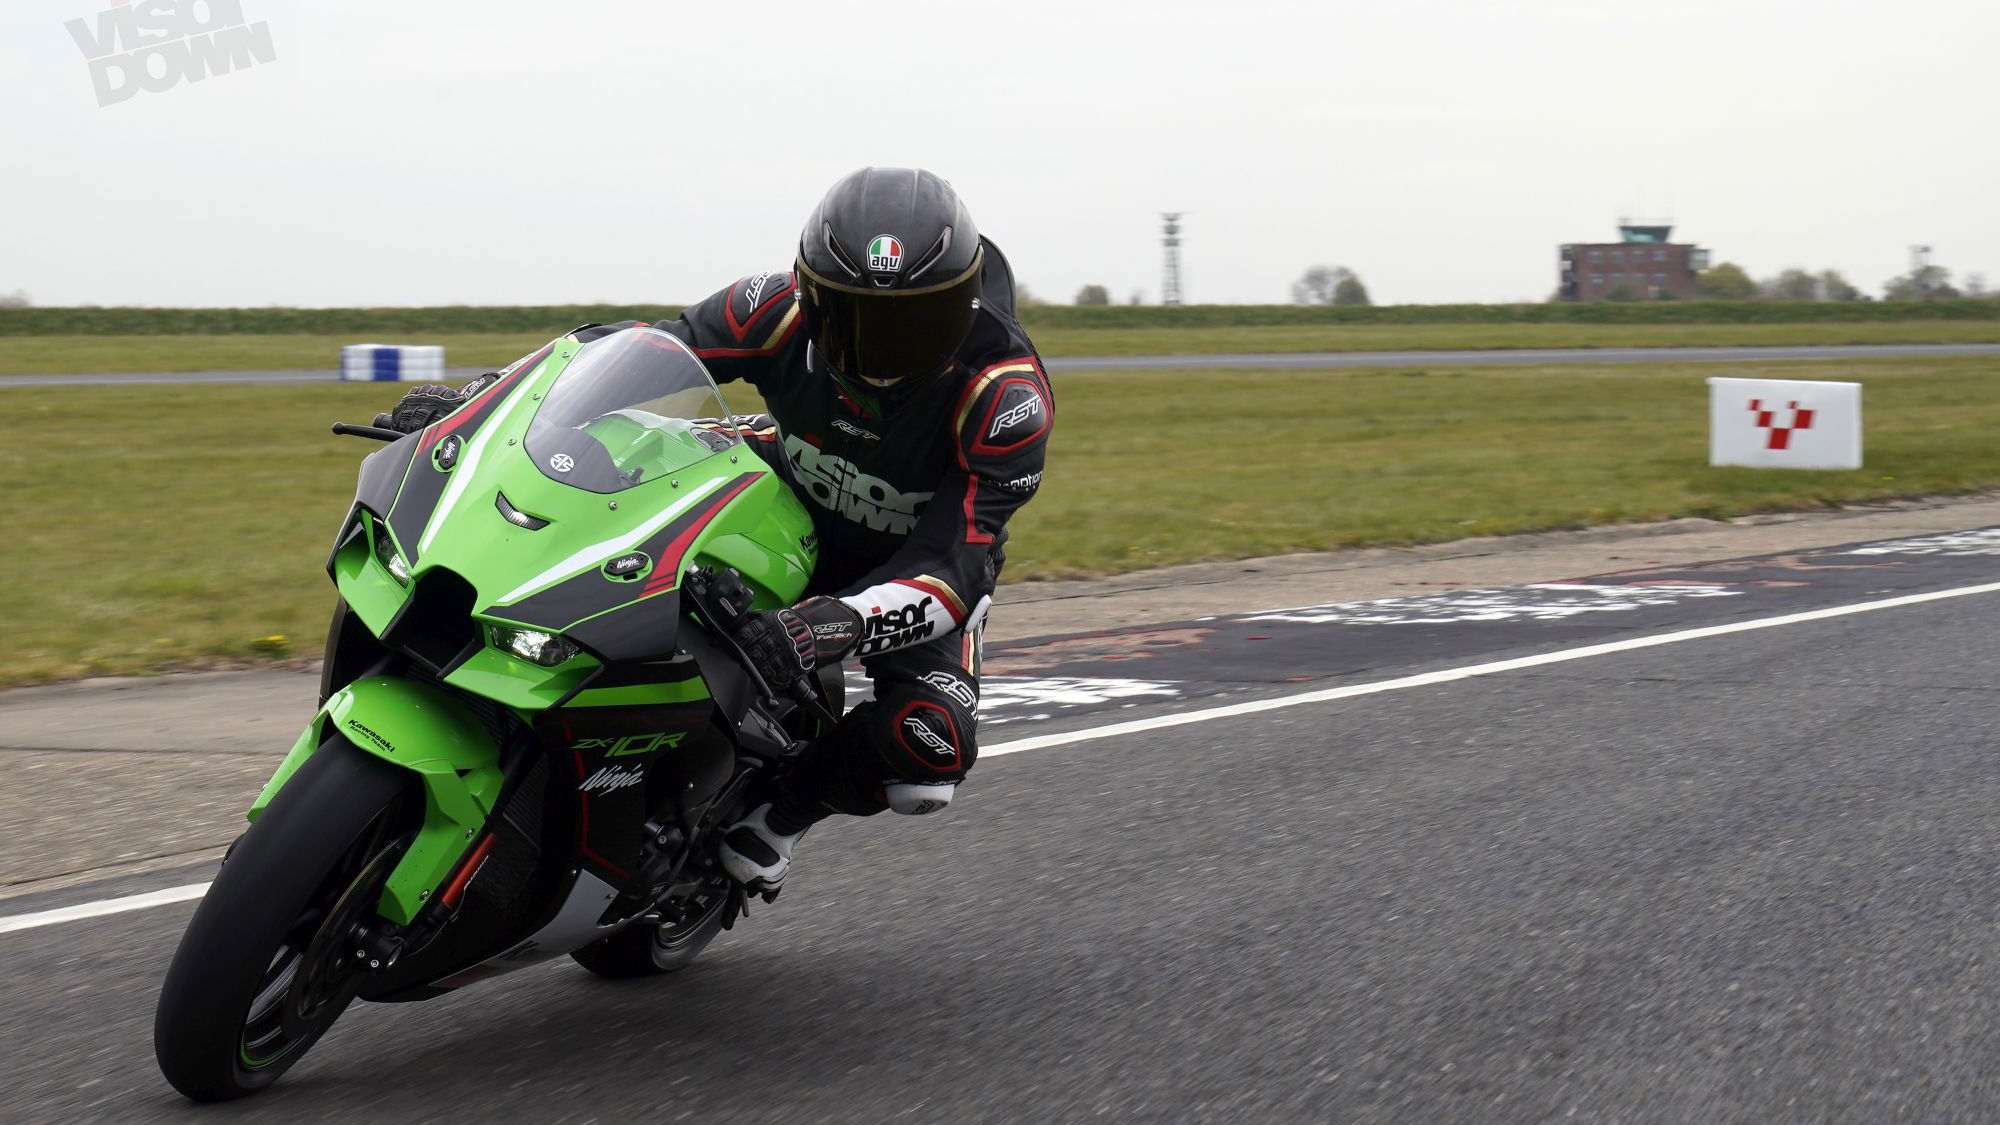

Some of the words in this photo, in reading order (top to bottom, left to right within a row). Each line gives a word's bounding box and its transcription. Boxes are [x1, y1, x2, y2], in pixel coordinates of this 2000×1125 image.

[871, 255, 899, 270] agv
[831, 419, 881, 441] RST
[989, 394, 1041, 439] RST
[616, 556, 640, 569] Ninja
[812, 621, 853, 634] RST
[852, 620, 935, 658] DOWN
[348, 719, 396, 752] Kawasaki
[903, 717, 956, 756] RST
[578, 763, 644, 798] Ninja
